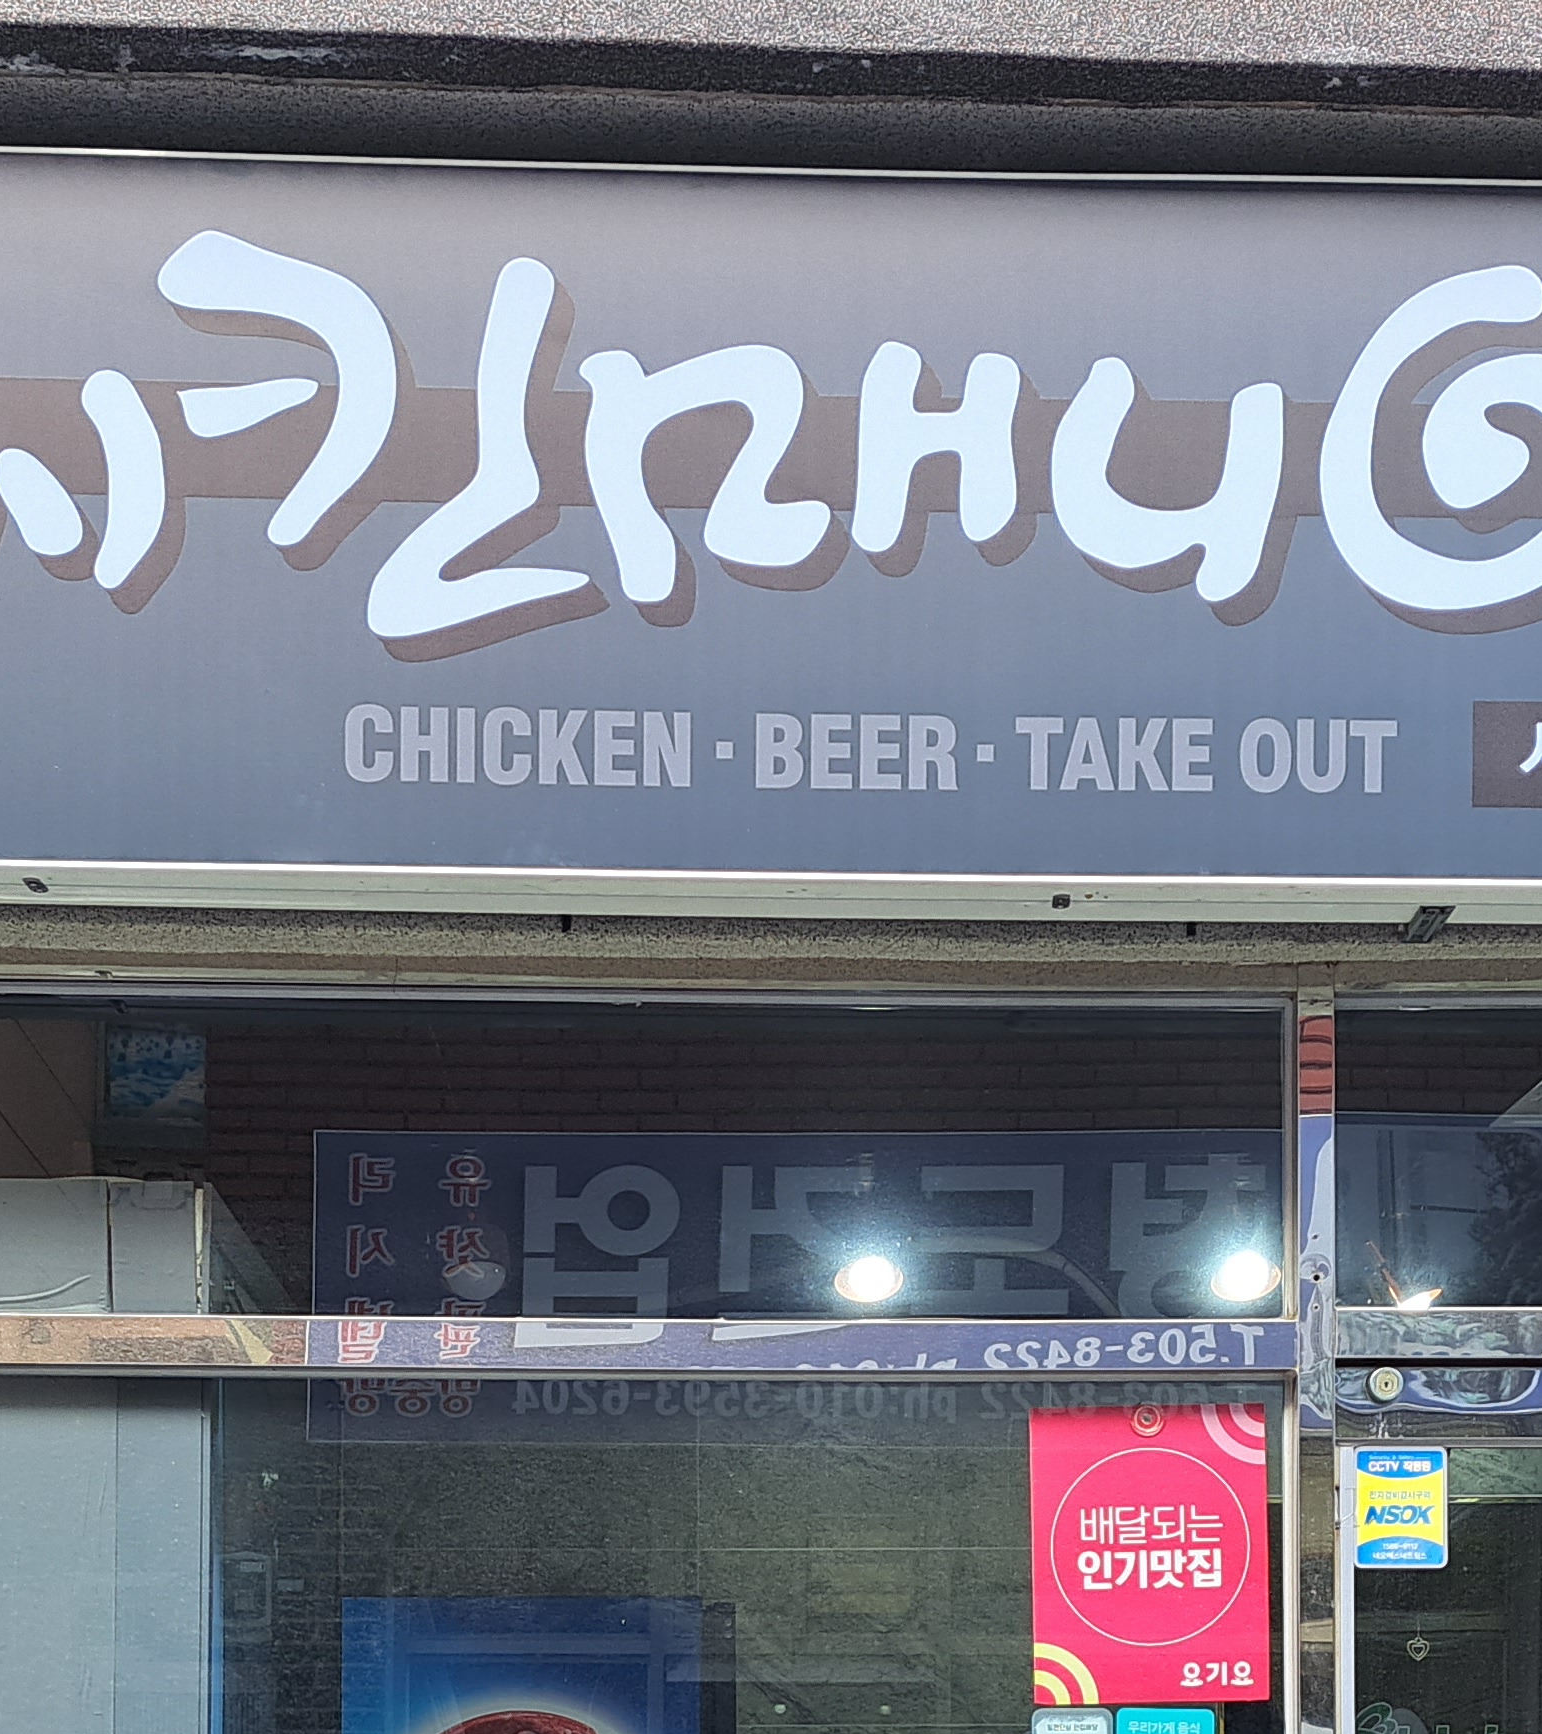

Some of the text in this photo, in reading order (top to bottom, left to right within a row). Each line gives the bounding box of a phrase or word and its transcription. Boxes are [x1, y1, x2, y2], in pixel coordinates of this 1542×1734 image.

[343, 702, 1398, 795] CHICKEN BEER TAKE OUT
[1368, 1461, 1400, 1472] CCTV
[1079, 1505, 1224, 1543] 배달되는
[1364, 1505, 1435, 1525] NSOK
[1077, 1549, 1223, 1590] 인기맛집
[1180, 1661, 1255, 1686] 요기요
[1128, 1721, 1175, 1734] 우리가게
